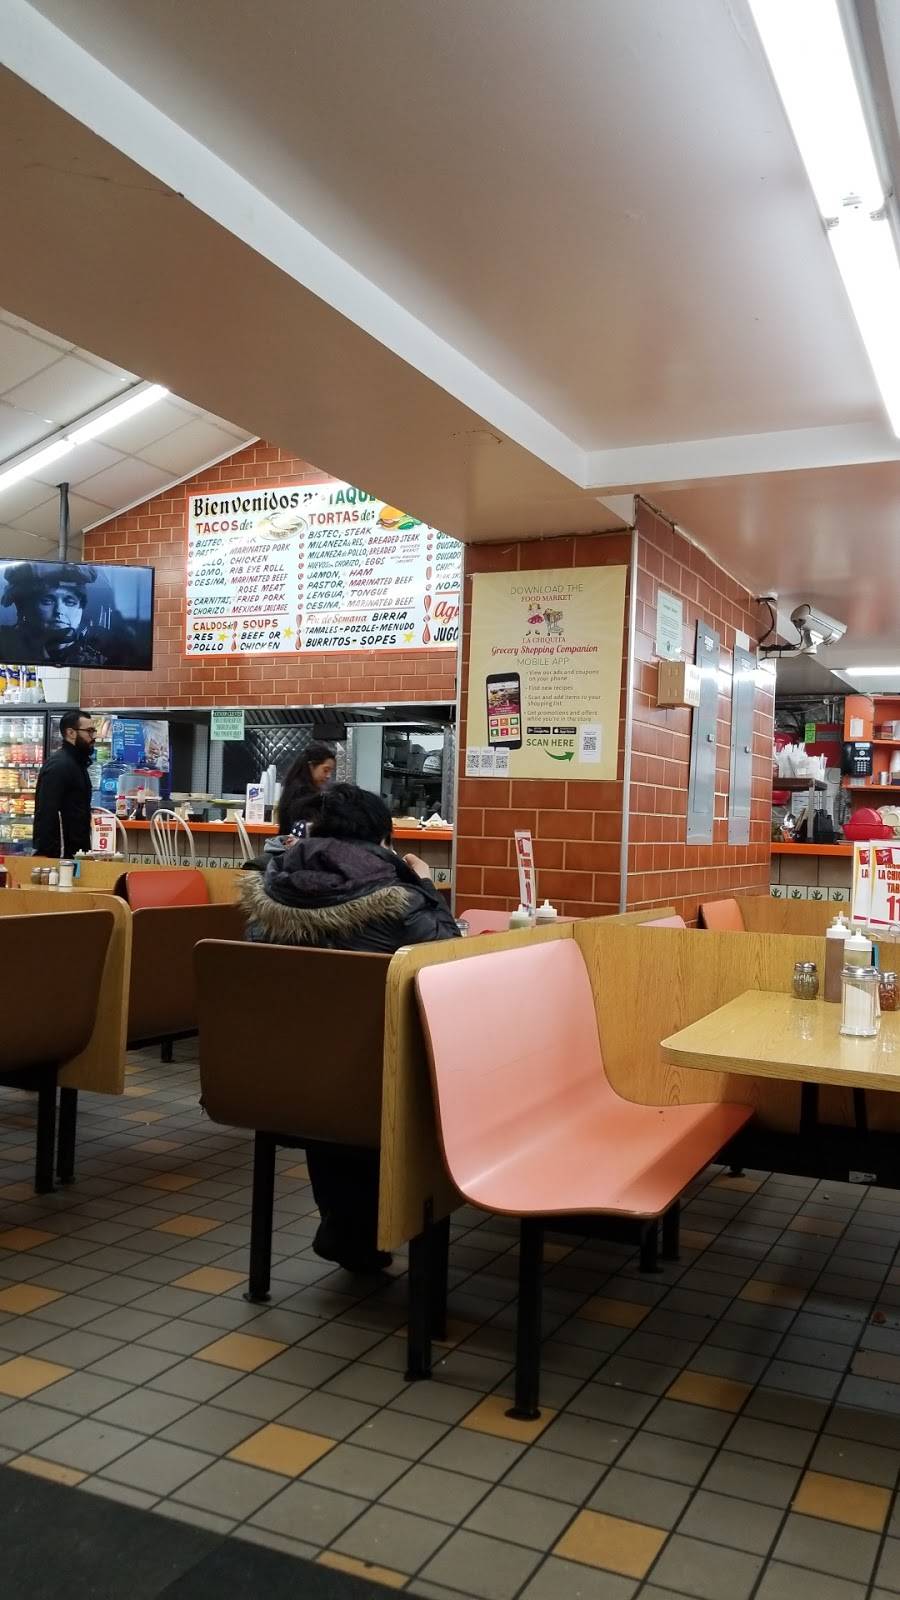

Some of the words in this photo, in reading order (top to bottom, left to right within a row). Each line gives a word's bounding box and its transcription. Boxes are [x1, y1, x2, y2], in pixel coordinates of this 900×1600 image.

[194, 492, 299, 517] Bienvenidos
[308, 510, 359, 525] TORTAS
[196, 520, 238, 533] TACOS
[344, 527, 372, 537] STEAK
[367, 535, 399, 545] BREADED
[400, 533, 420, 542] STEAK
[271, 543, 290, 552] PORK
[368, 546, 396, 555] BREADED
[230, 555, 269, 565] CHICKEN
[364, 557, 386, 566] EGGS
[195, 568, 223, 577] LOMO,
[229, 566, 243, 574] RIB
[246, 565, 261, 573] EYE
[262, 564, 284, 572] ROLL
[349, 568, 374, 577] HAM
[271, 573, 288, 581] BEEF
[260, 583, 286, 592] MEAT
[307, 580, 345, 590] PASTOR,
[349, 577, 392, 587] MARINATED
[394, 576, 414, 584] BEEF
[306, 590, 345, 600] LENGUA,
[350, 588, 388, 597] TONGUE
[510, 585, 564, 595] DOWNLOAD
[567, 583, 584, 593] THE
[236, 594, 259, 603] FRIED
[262, 593, 286, 601] PORK
[395, 597, 414, 606] BEEF
[193, 606, 225, 616] CHORIZO
[231, 604, 262, 614] MEXICAN
[371, 611, 408, 622] BIRRIA
[193, 621, 227, 631] CALDOS
[243, 618, 279, 629] SOUPS
[193, 633, 214, 641] RES
[241, 631, 265, 640] BEEF
[268, 631, 281, 639] OR
[305, 635, 350, 648] BURRITOS
[360, 634, 396, 646] SOPES
[192, 643, 224, 652] POLLO
[240, 641, 281, 651] CHICKEN
[491, 646, 519, 656] Grocery
[520, 645, 554, 655] Shopping
[556, 644, 598, 654] Companion
[517, 658, 549, 666] MOBILE
[551, 657, 570, 665] APP
[526, 739, 549, 747] SCAN
[551, 739, 574, 747] HERE
[99, 837, 108, 849] 9
[878, 869, 886, 880] LA
